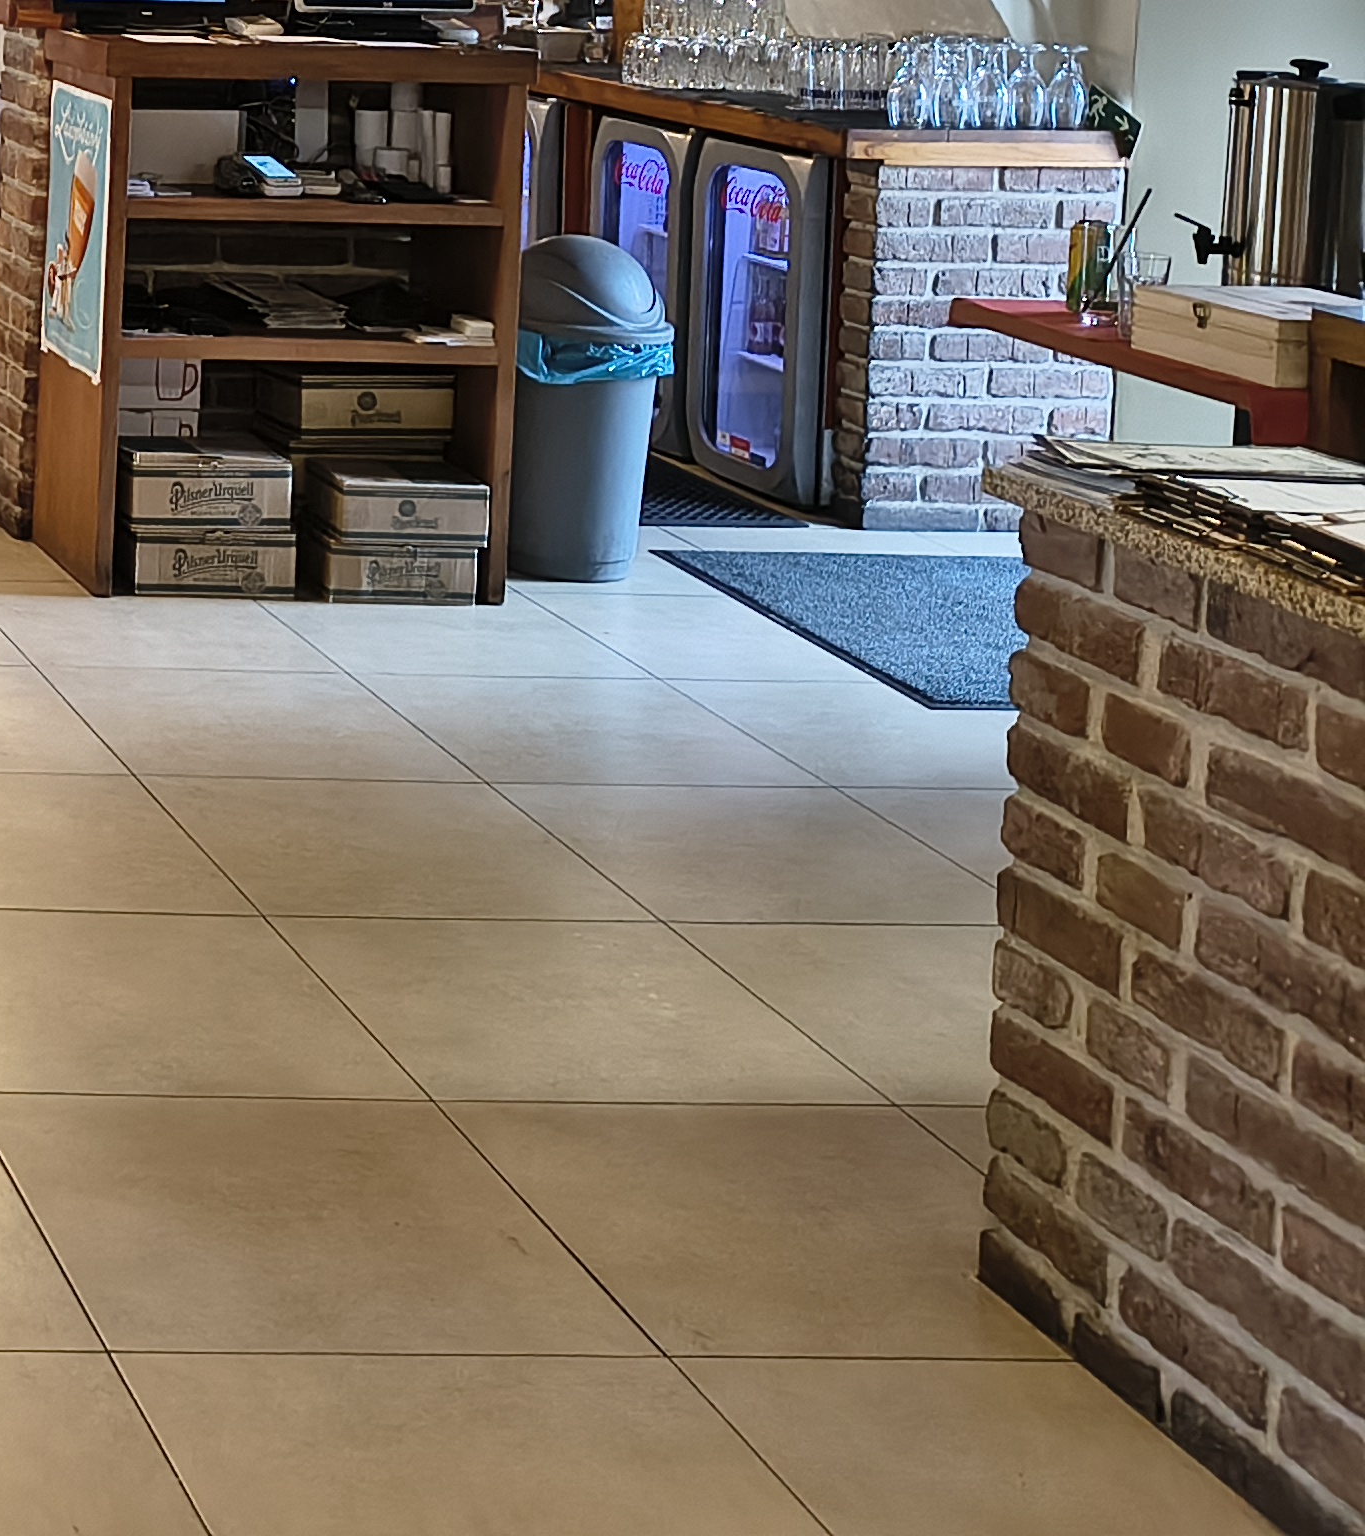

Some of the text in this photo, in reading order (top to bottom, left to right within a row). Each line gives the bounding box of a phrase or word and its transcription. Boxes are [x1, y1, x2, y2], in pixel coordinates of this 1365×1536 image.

[170, 480, 254, 512] Pilsner Urquell
[173, 548, 258, 578] Pilsner Urquell
